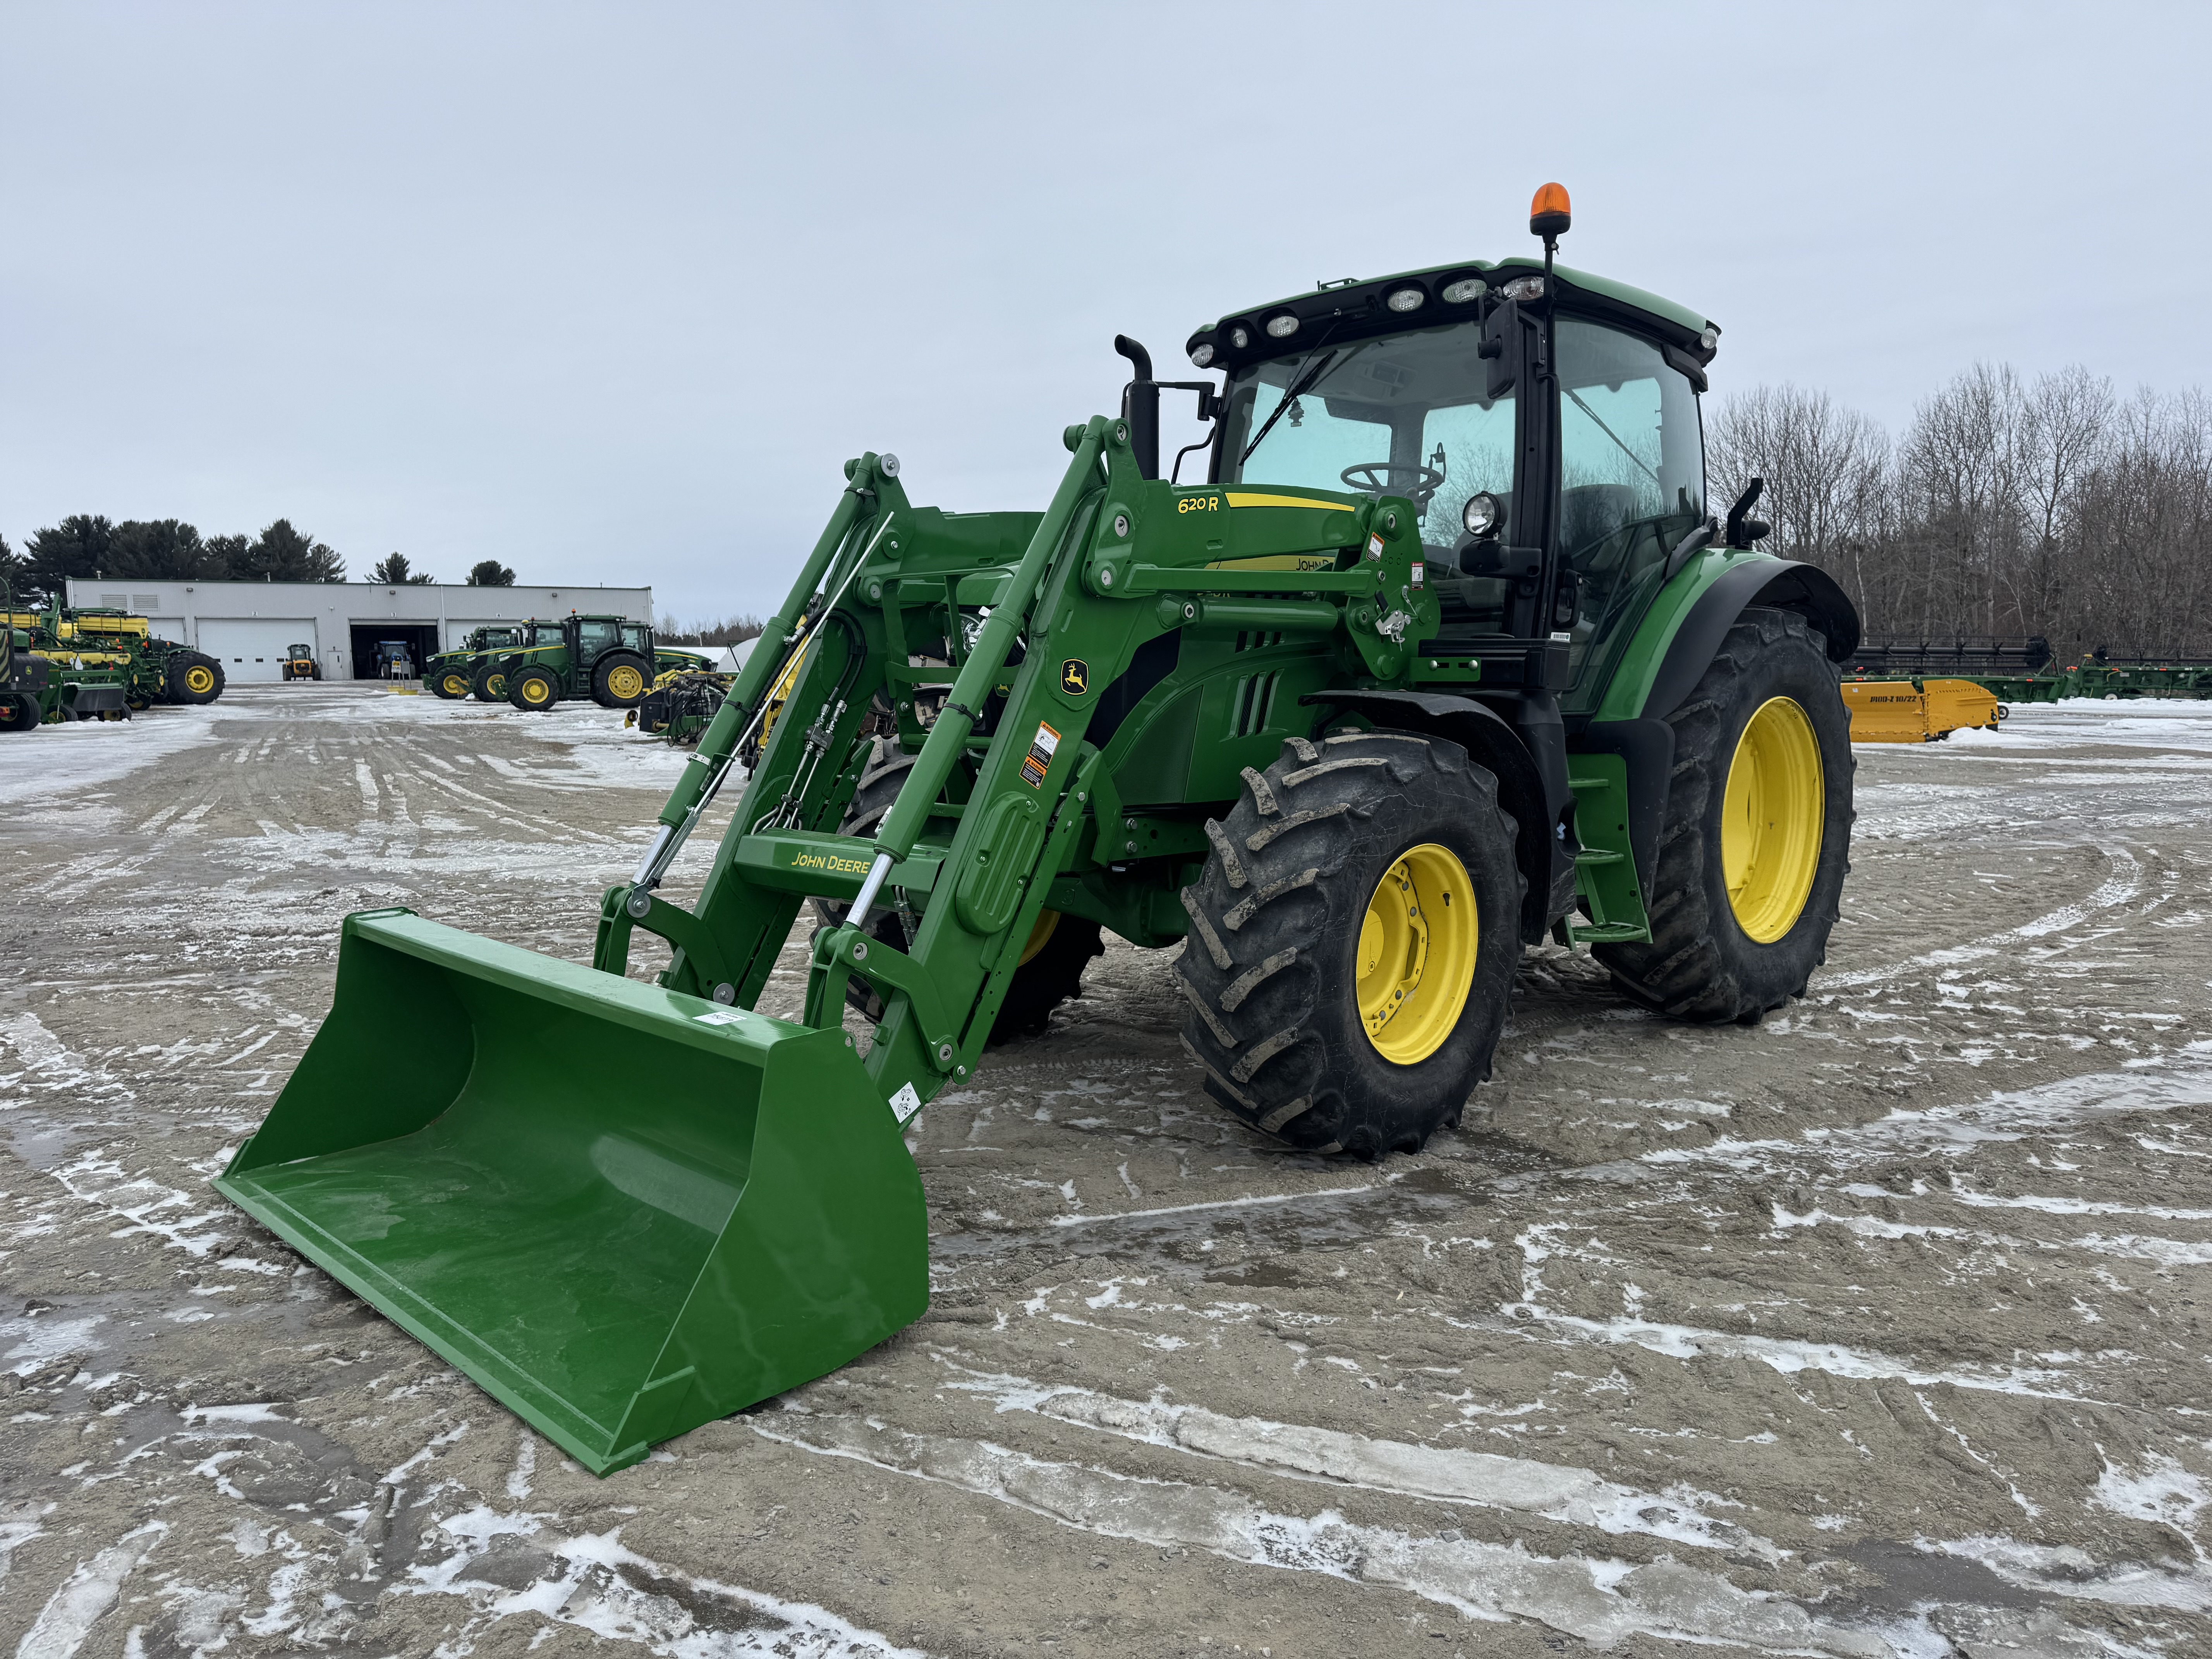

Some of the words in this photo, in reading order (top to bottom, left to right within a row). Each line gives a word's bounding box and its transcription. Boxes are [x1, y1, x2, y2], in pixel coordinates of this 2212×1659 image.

[1296, 558, 1321, 571] JOHN
[791, 852, 826, 868] JOHN
[827, 855, 871, 874] DEERE
